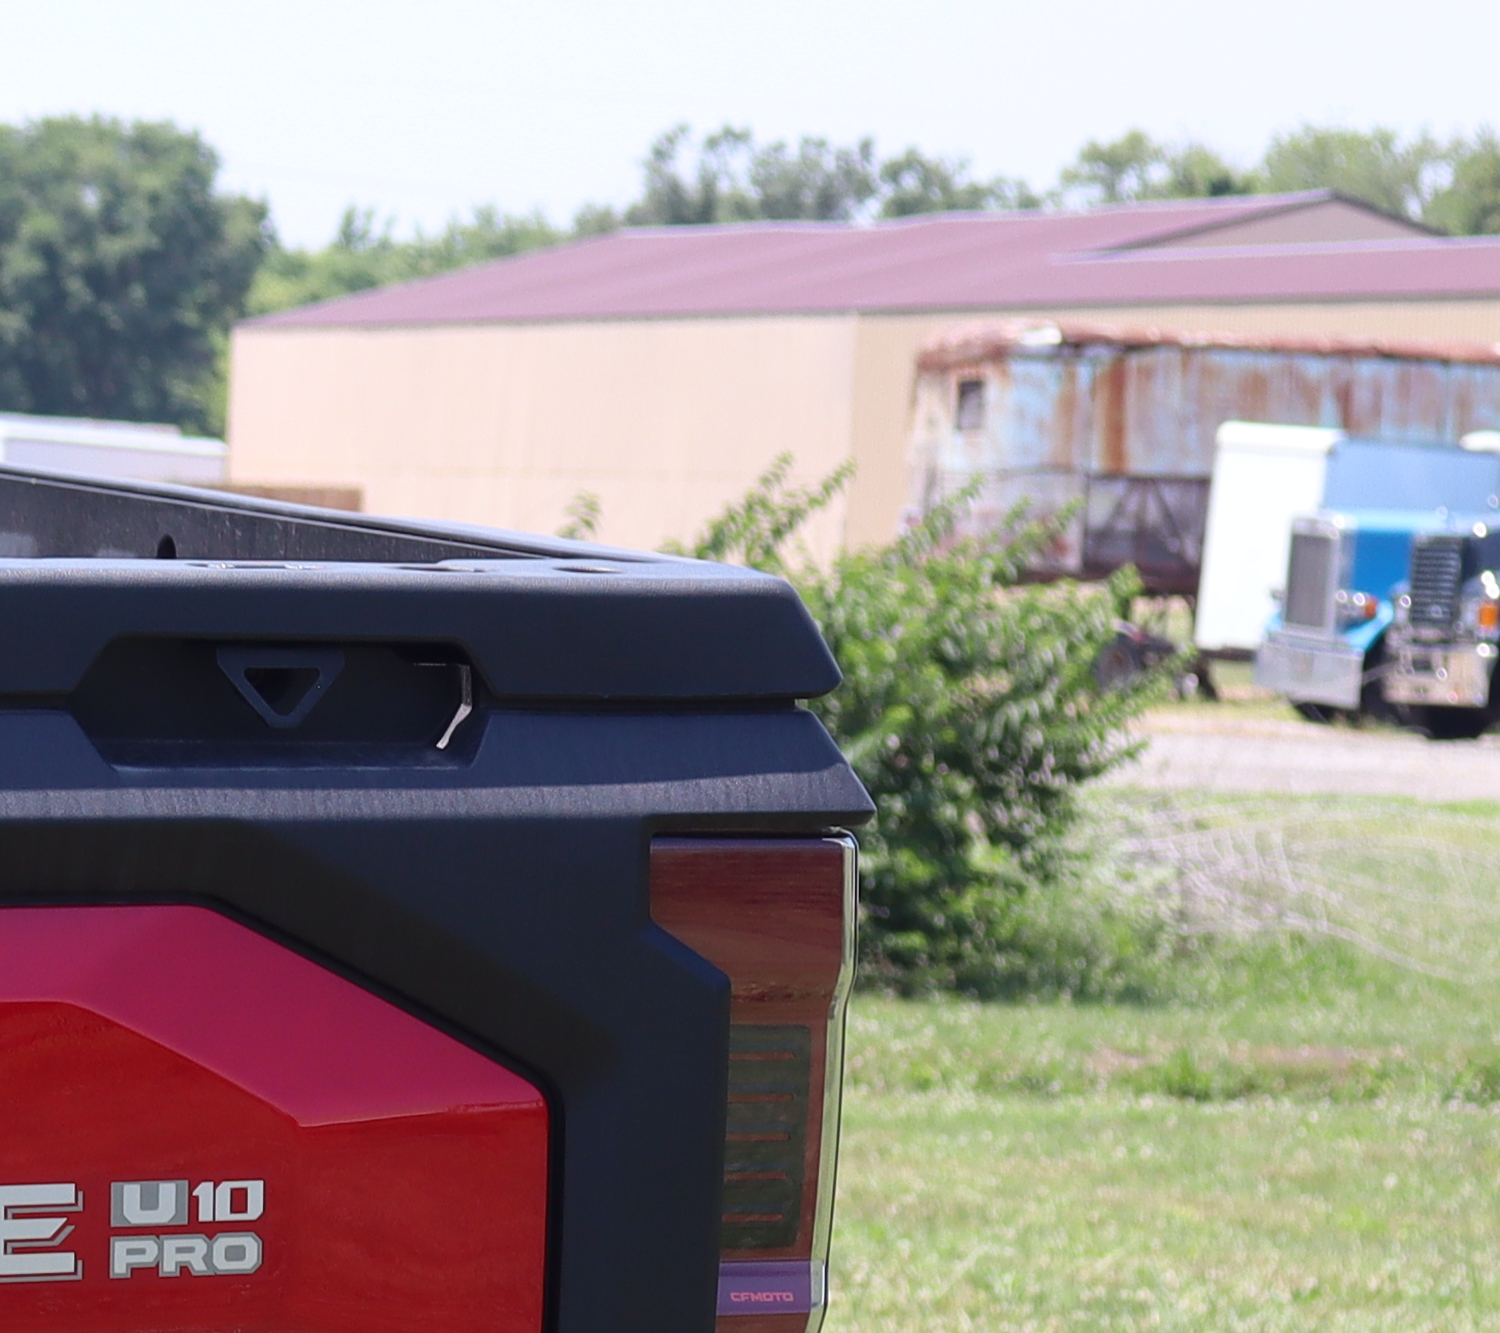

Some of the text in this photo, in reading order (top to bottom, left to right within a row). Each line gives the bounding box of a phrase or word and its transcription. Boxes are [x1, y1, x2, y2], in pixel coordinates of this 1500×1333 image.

[110, 1179, 266, 1228] U10
[109, 1232, 265, 1279] PRO
[729, 1291, 795, 1303] CFMOTO
